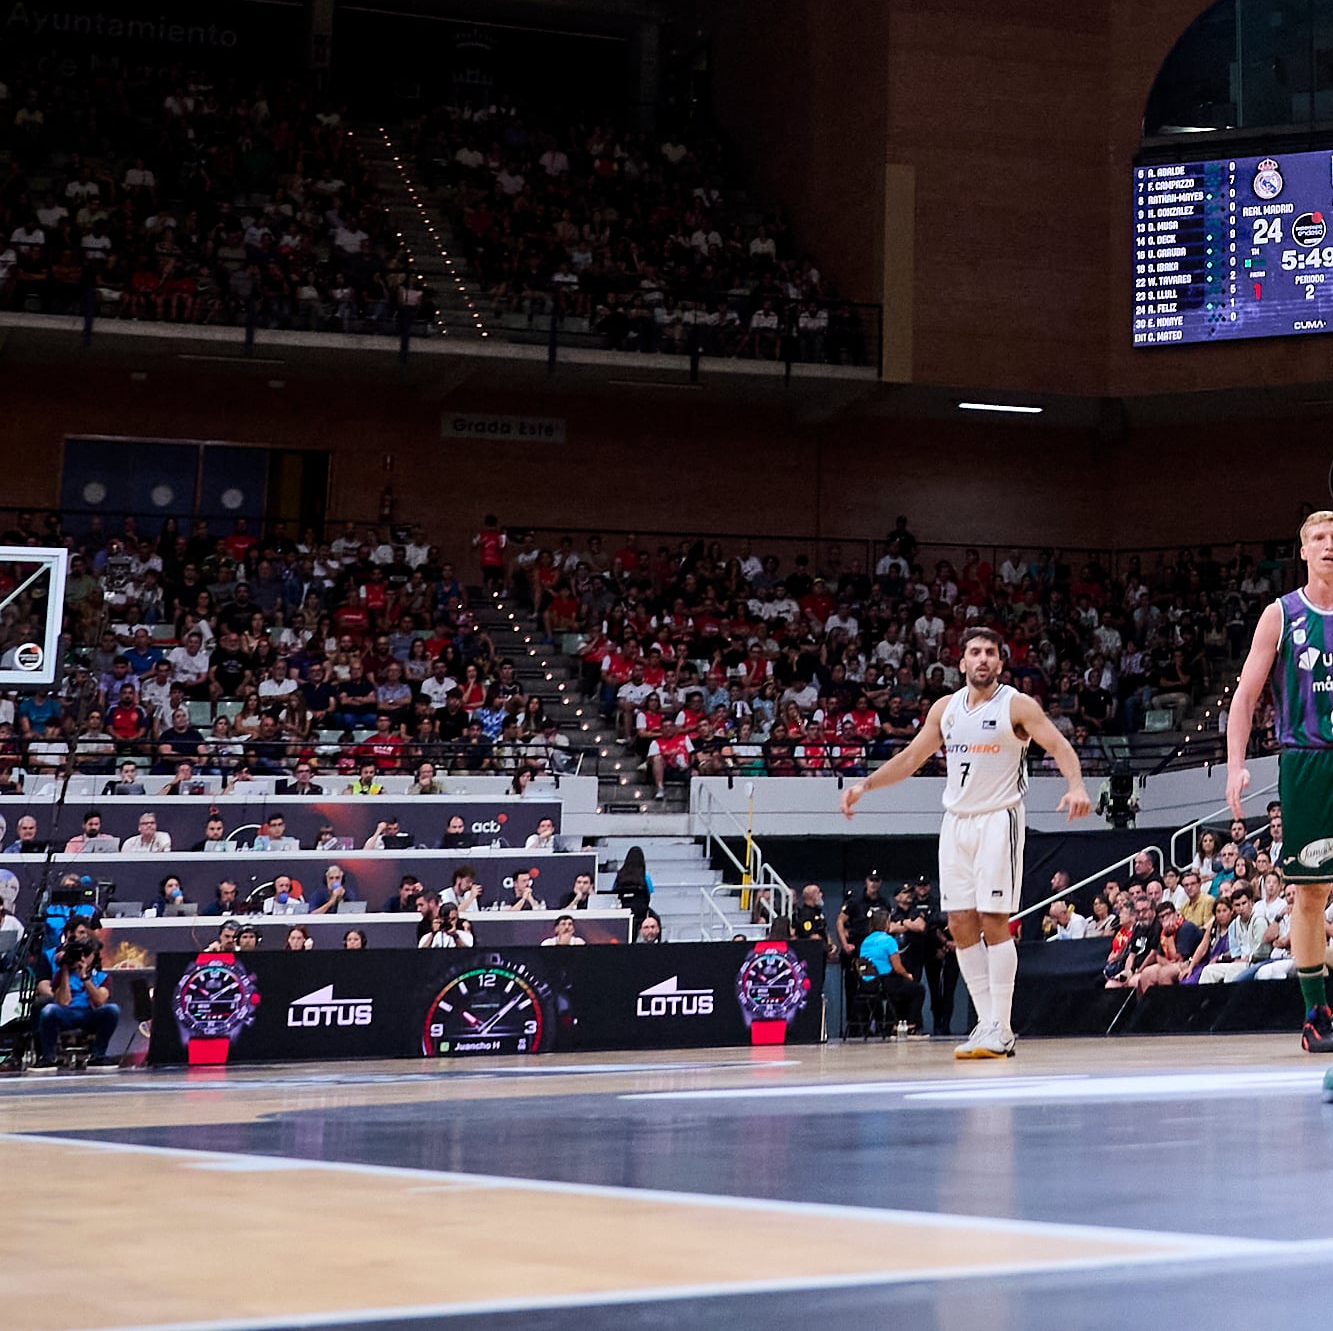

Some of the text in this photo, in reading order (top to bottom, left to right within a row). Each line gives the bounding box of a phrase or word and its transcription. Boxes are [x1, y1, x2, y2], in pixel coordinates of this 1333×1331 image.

[6, 1, 238, 50] Ayuntamiento
[1243, 203, 1294, 217] REAL MADRID
[1157, 221, 1178, 231] MUSA
[1253, 217, 1283, 245] 24
[1157, 234, 1176, 245] DECK
[1295, 274, 1324, 285] PERIODO
[1157, 289, 1177, 300] LLULL
[1253, 283, 1261, 300] 1
[1305, 284, 1315, 300] 2
[1157, 303, 1177, 313] FELIZ
[1294, 320, 1324, 330] CUMA
[1157, 330, 1182, 342] MATEO
[454, 418, 510, 433] Grada
[960, 762, 971, 787] 7
[471, 820, 500, 833] acb
[478, 973, 497, 987] 12
[637, 995, 714, 1016] LOTUS
[287, 1004, 373, 1027] LOTUS
[430, 1023, 444, 1037] 9
[524, 1020, 537, 1034] 3
